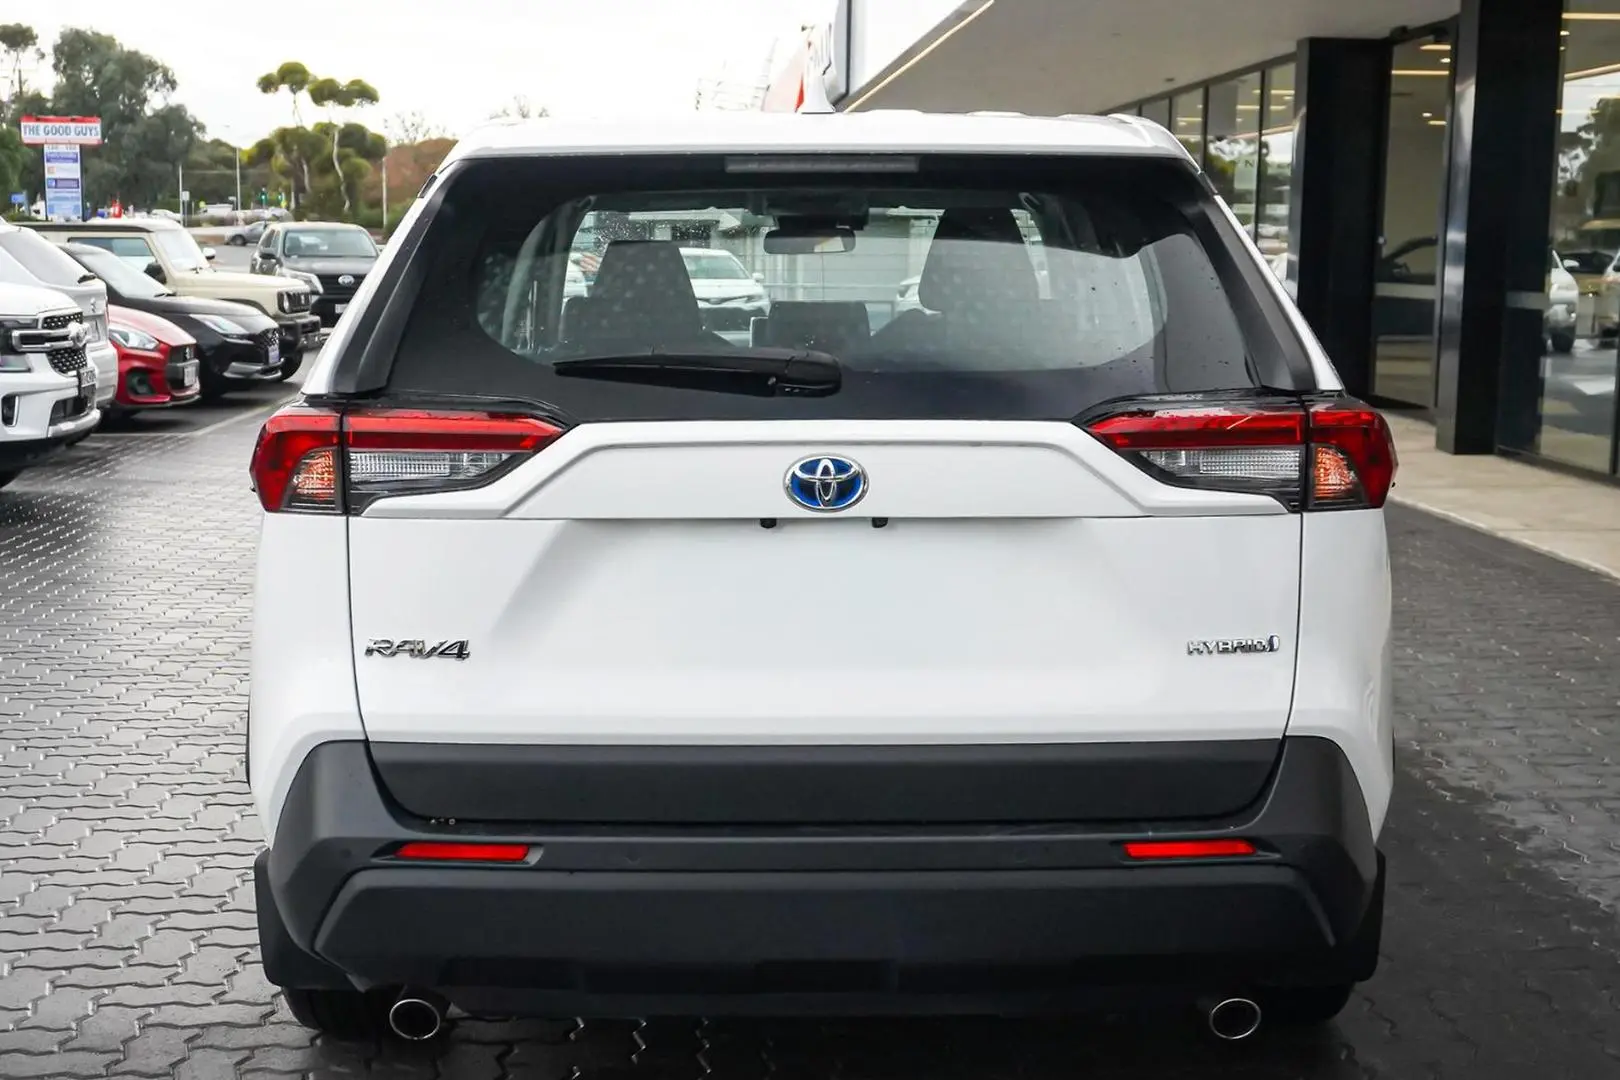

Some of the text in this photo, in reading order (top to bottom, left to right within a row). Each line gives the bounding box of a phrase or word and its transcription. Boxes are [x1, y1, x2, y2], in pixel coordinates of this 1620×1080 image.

[23, 125, 99, 137] THE GOOD GUYS
[364, 639, 471, 660] RAV4
[1186, 639, 1266, 655] HYBRID
